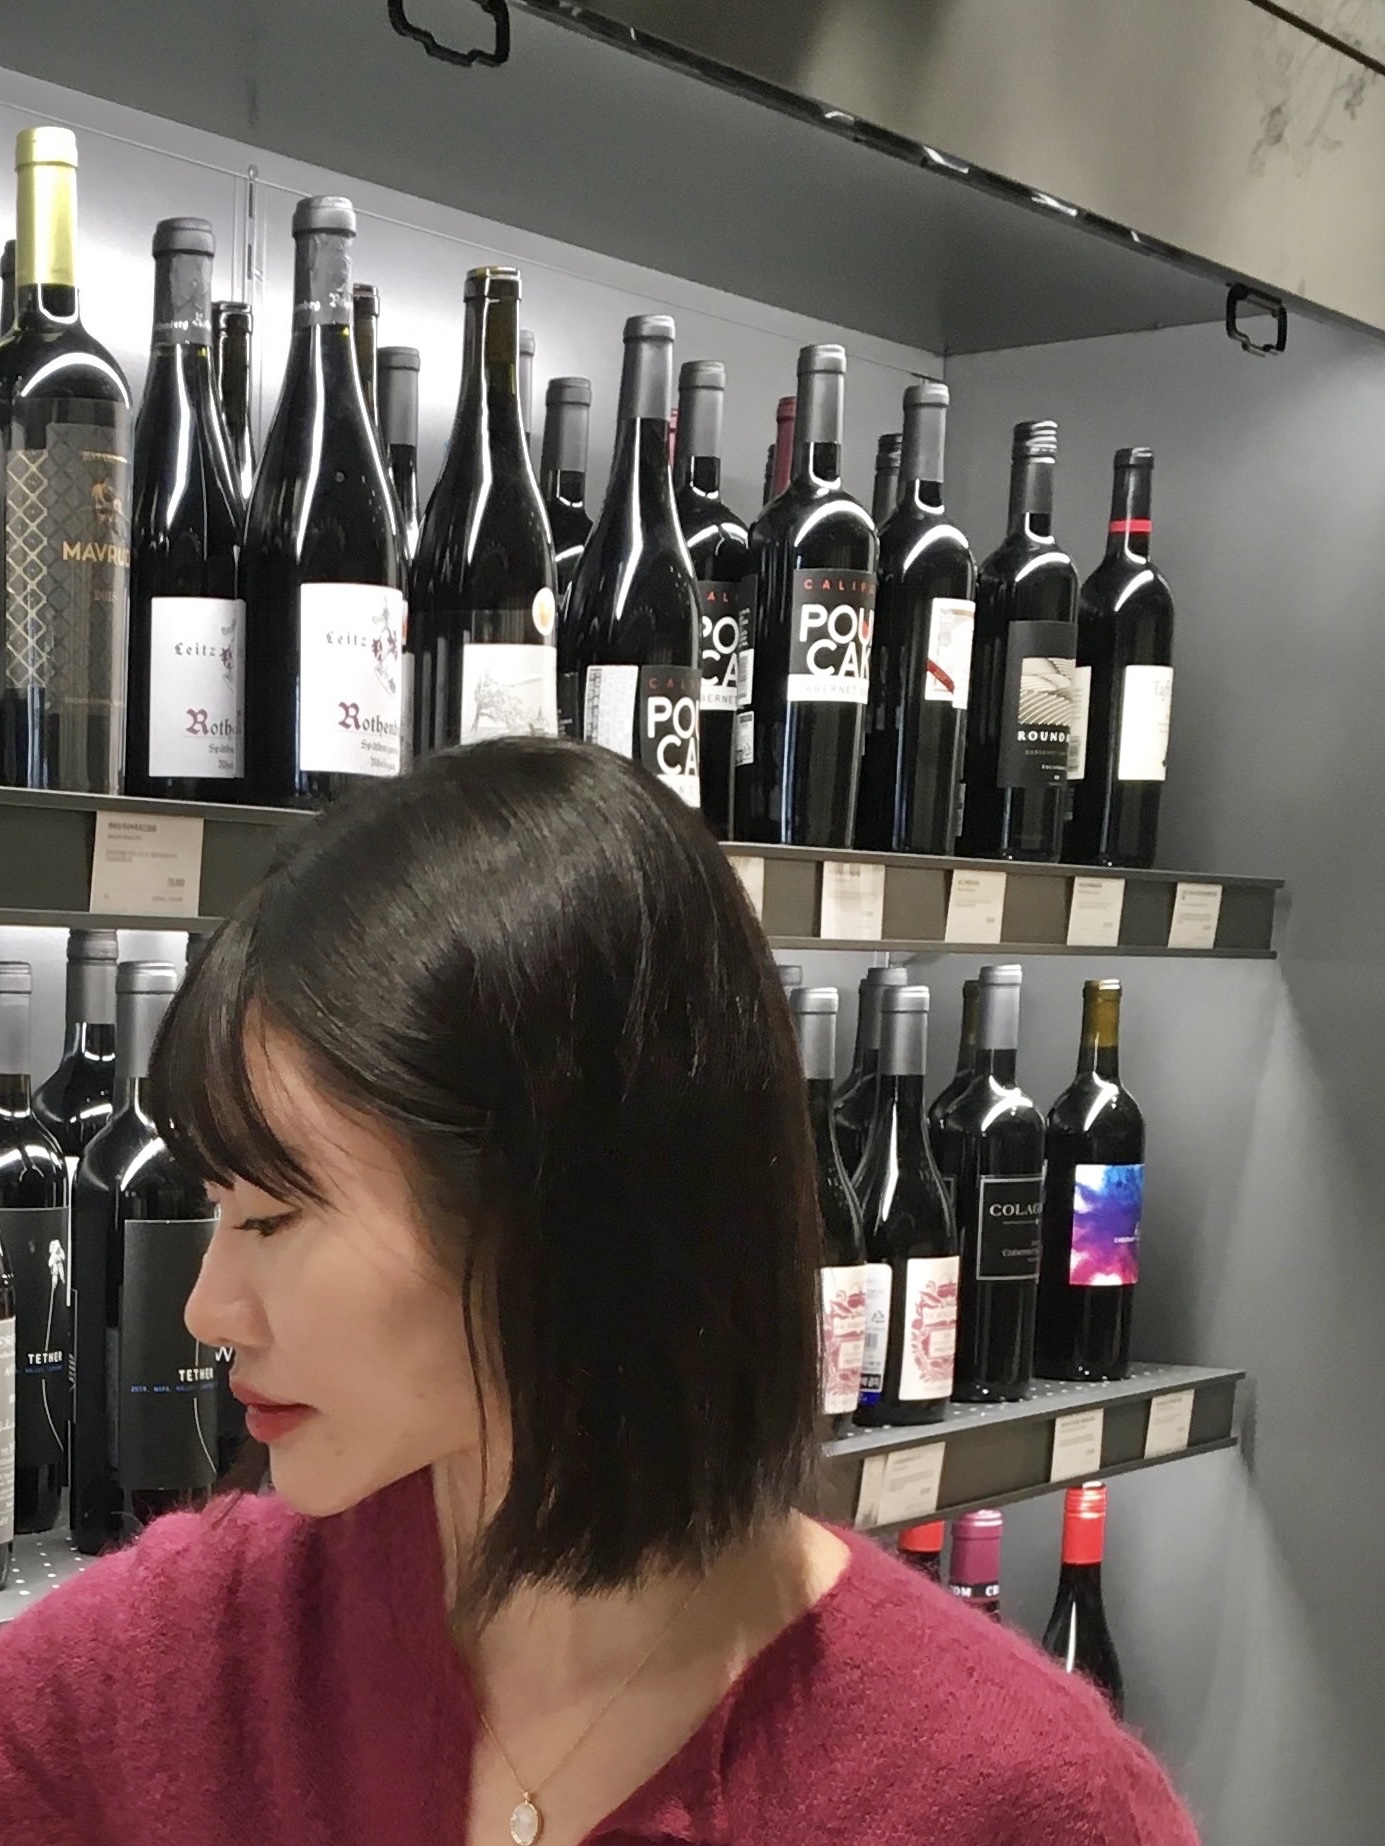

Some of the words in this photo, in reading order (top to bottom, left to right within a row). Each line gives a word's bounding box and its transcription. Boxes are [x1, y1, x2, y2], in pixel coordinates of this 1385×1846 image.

[326, 631, 367, 648] Leitz
[174, 642, 216, 657] Leitz
[28, 1351, 63, 1365] TETHER
[178, 1367, 214, 1382] TETHER
